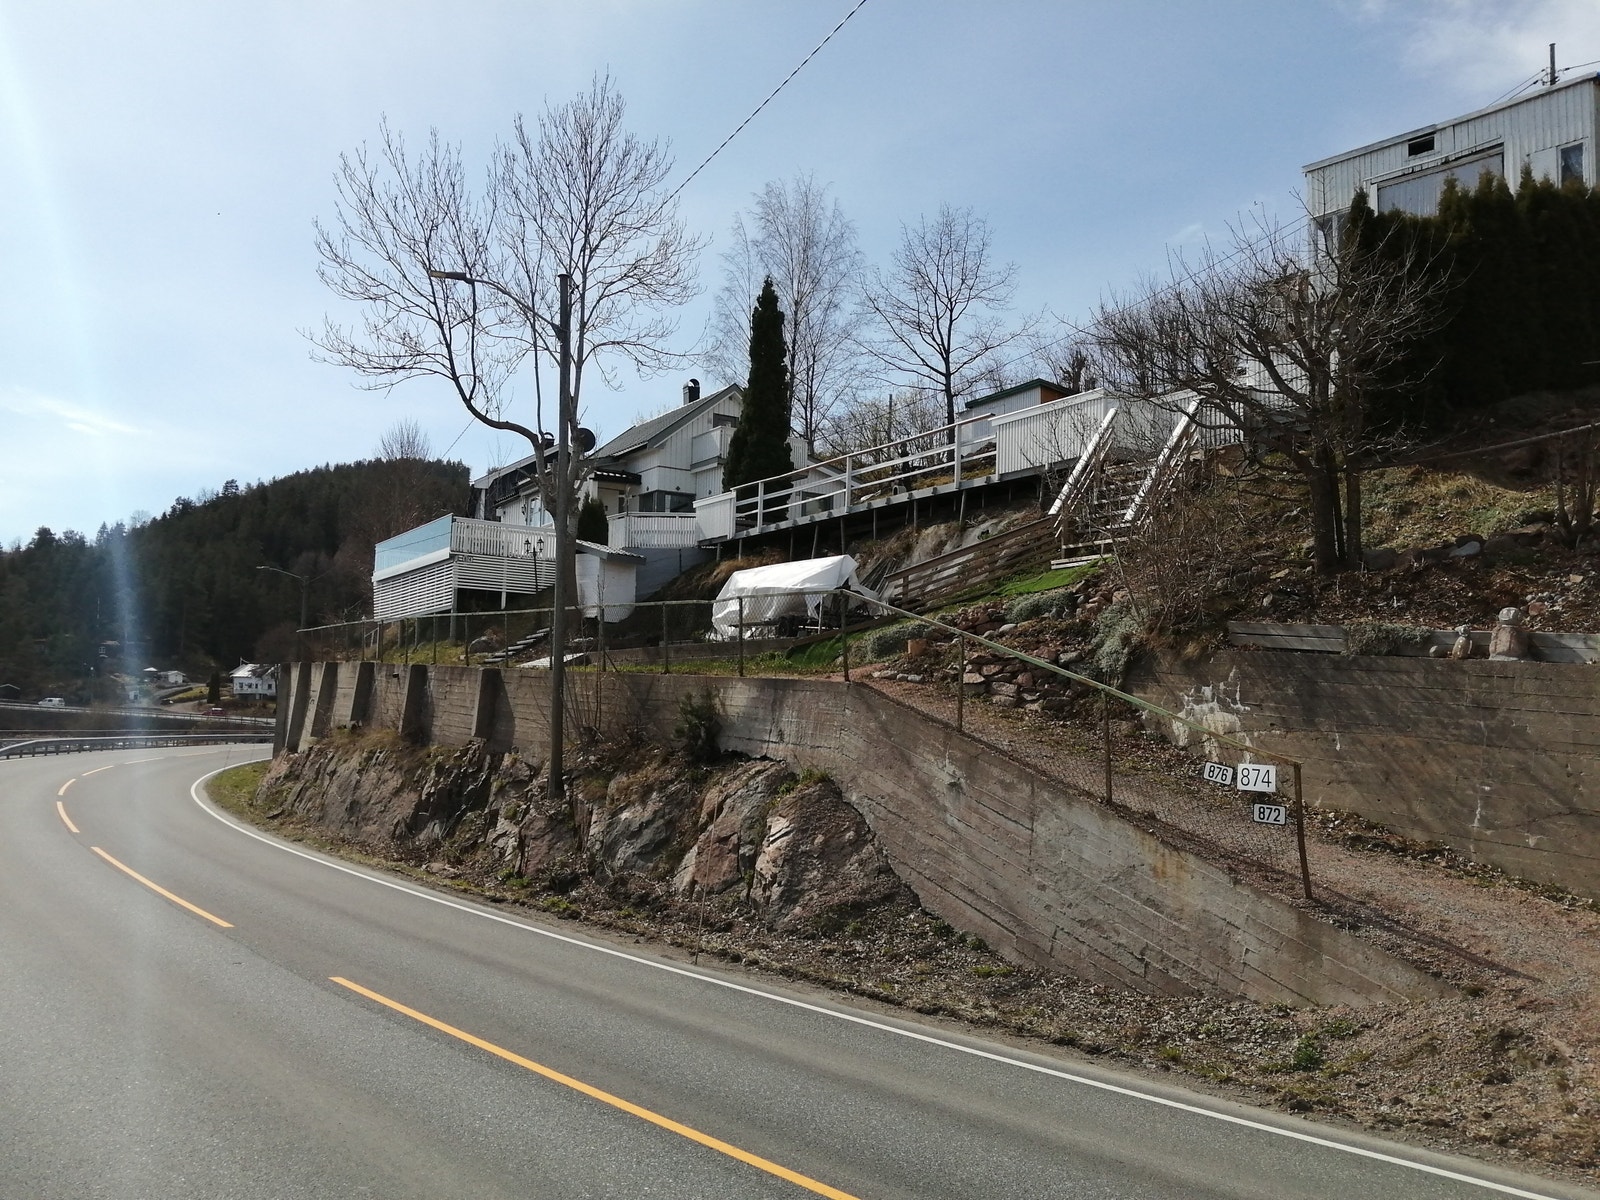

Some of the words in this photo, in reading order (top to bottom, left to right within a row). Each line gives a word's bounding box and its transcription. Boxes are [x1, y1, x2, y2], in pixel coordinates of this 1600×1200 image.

[1208, 765, 1229, 782] 876
[1240, 767, 1272, 788] 874
[1258, 806, 1281, 822] 872
